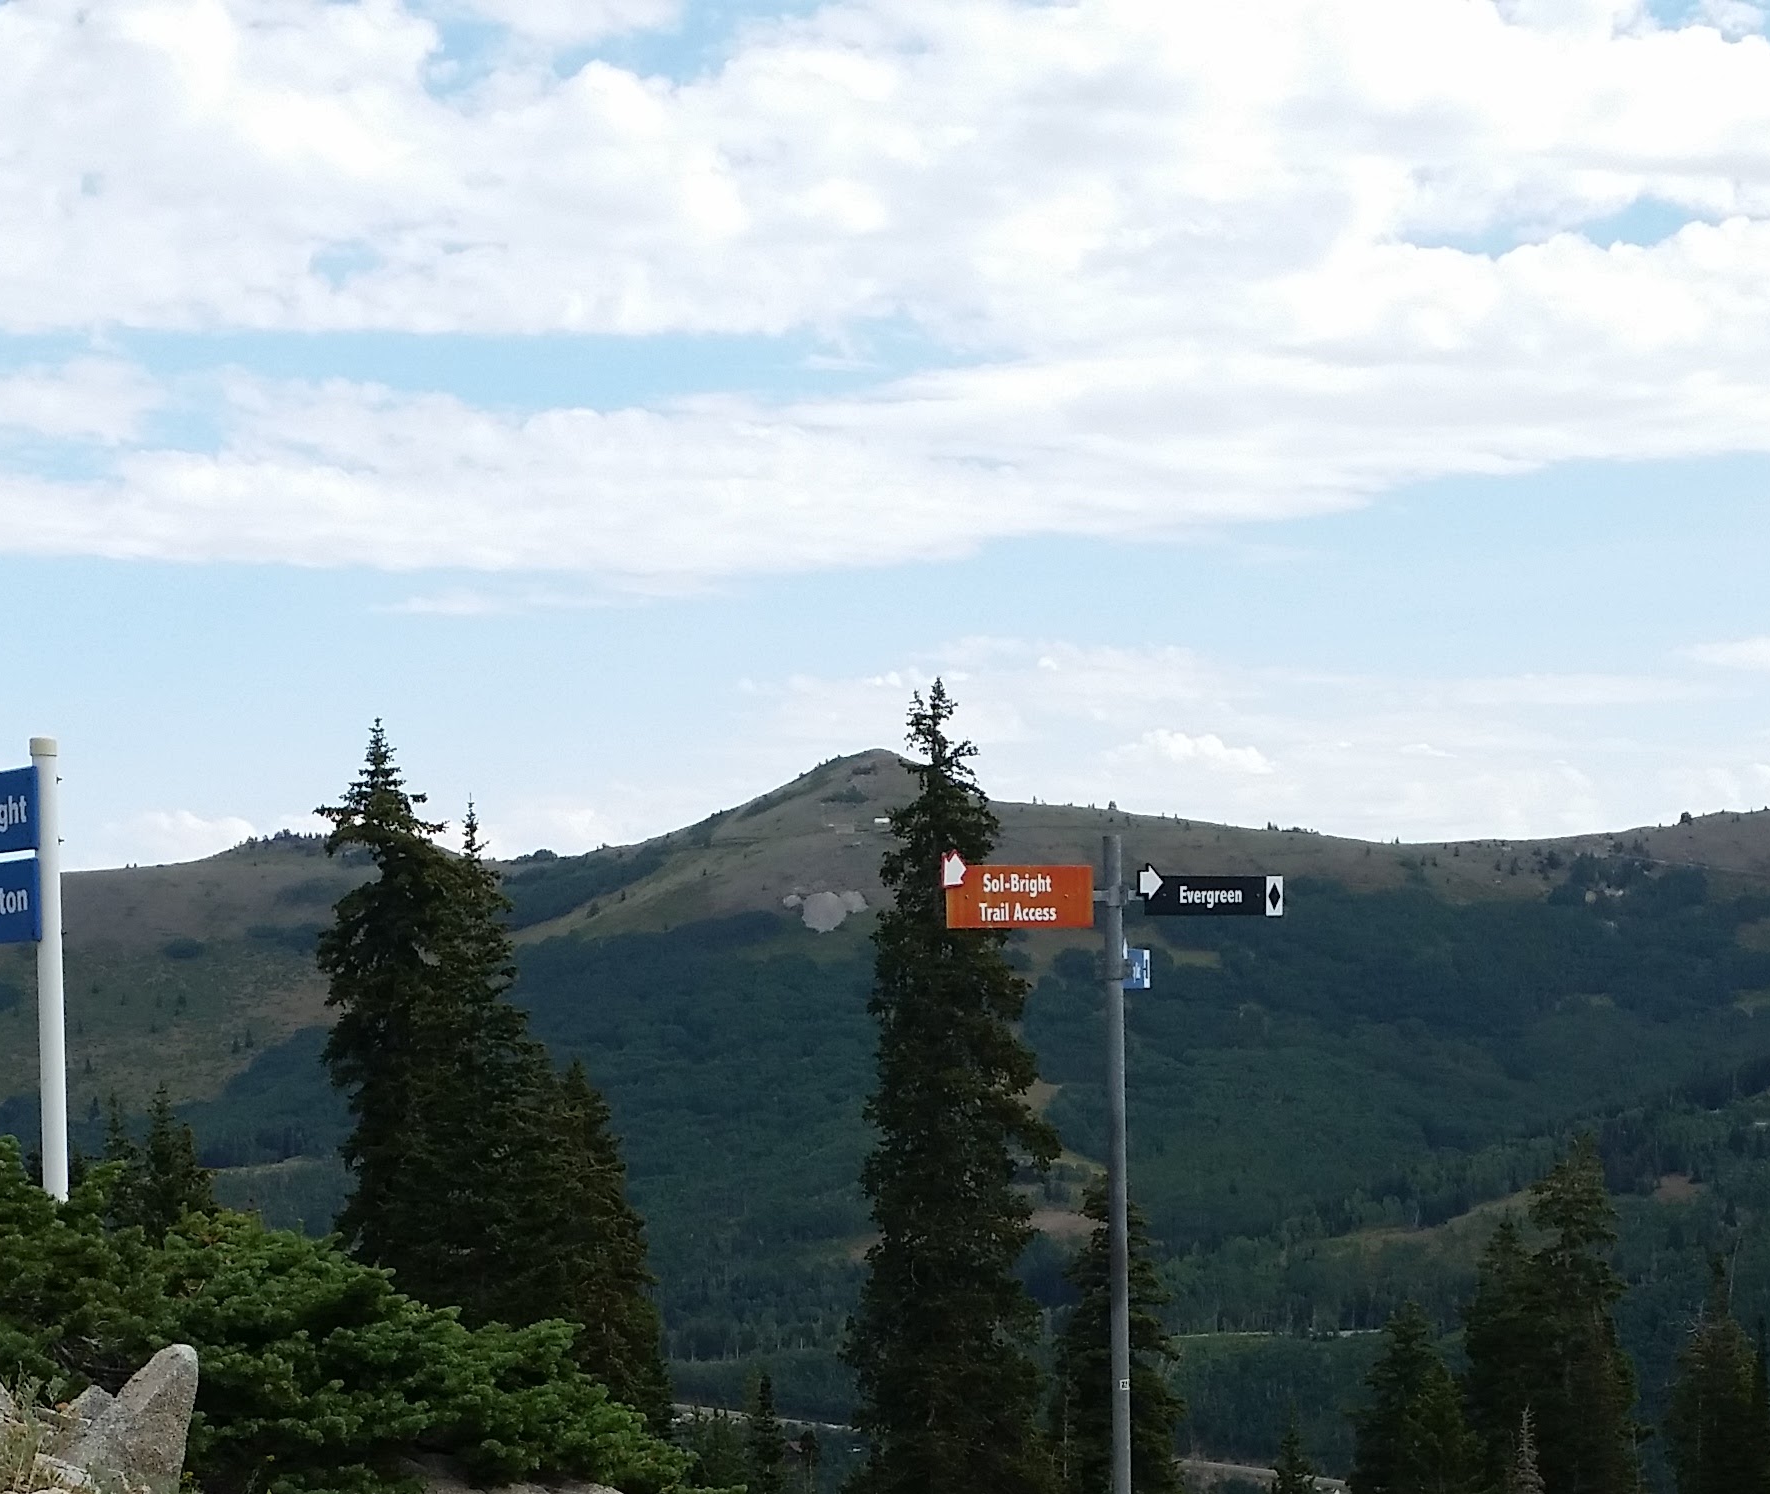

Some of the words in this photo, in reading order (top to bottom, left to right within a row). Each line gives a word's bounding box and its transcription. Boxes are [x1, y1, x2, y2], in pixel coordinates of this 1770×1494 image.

[982, 873, 1052, 898] Sol-Bright
[1179, 885, 1243, 909] Evergreen
[979, 902, 1010, 922] Trail
[1013, 902, 1057, 922] Access
